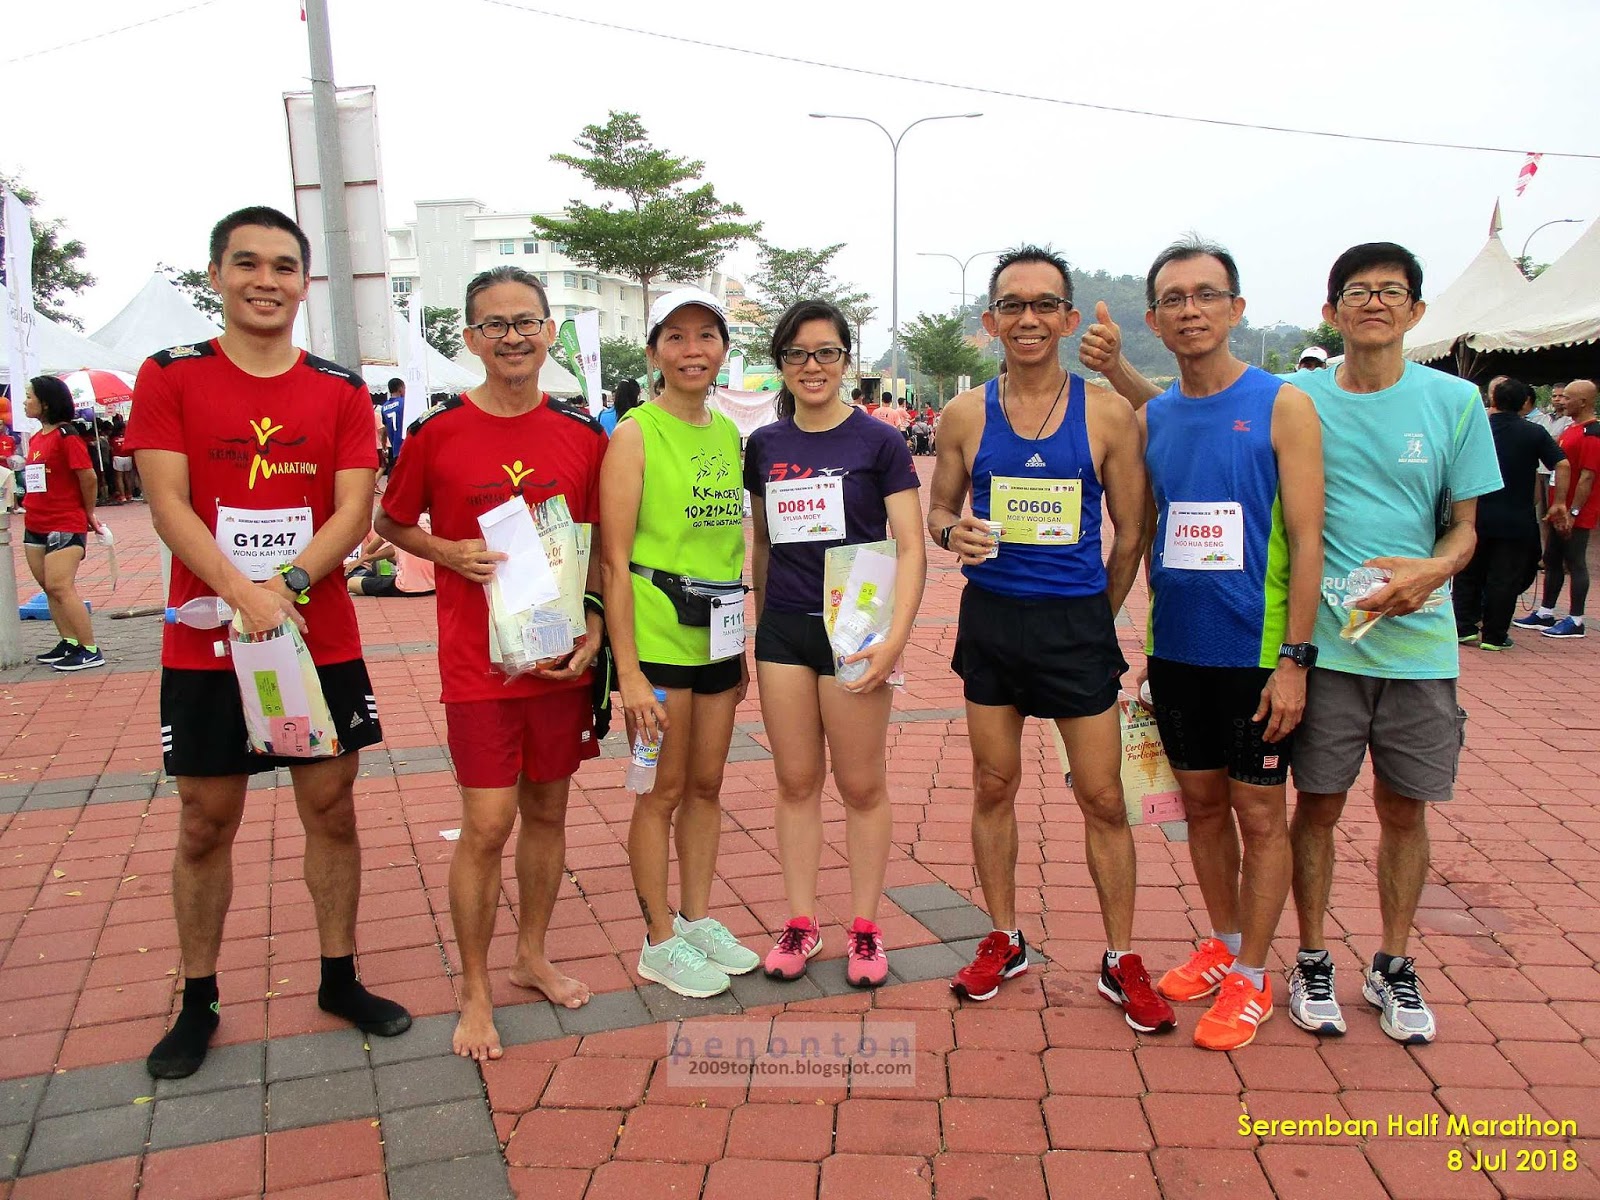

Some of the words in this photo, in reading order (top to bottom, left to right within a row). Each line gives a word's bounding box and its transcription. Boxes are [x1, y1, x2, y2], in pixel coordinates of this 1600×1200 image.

[387, 411, 398, 431] 7
[248, 454, 317, 490] MARATHON
[778, 498, 826, 514] D0814
[1007, 499, 1062, 514] C0606
[803, 513, 821, 521] MOEY
[1027, 515, 1046, 523] WOOI
[1174, 524, 1223, 539] J1689
[234, 532, 296, 548] G1247
[1188, 540, 1203, 548] HUA
[1204, 540, 1224, 548] SENG
[232, 549, 258, 557] WONG
[1125, 741, 1161, 753] Certificate
